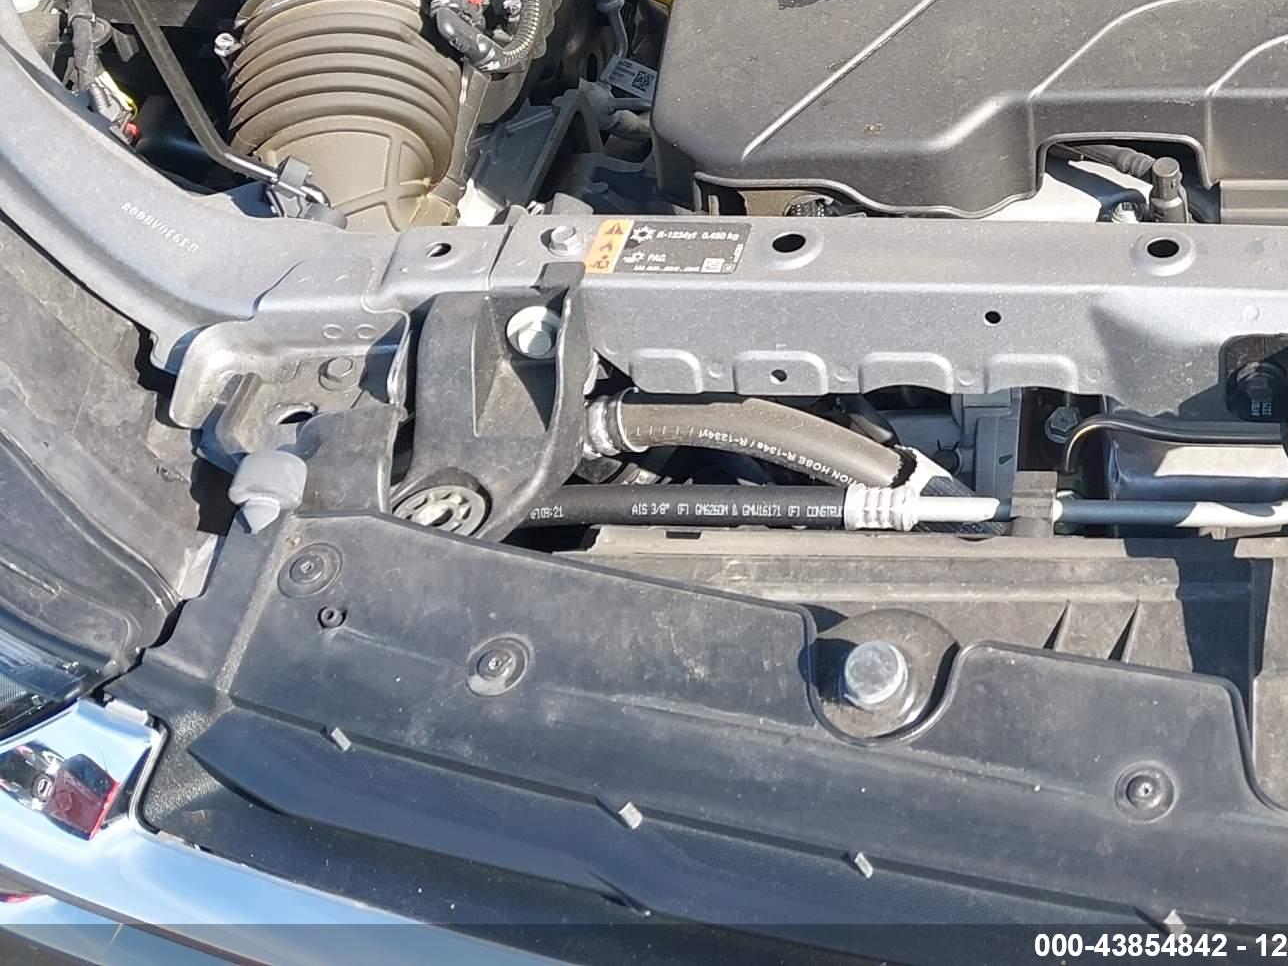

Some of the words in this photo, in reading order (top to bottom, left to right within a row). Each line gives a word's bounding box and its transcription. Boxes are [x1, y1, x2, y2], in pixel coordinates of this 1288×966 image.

[726, 232, 740, 242] kg
[647, 253, 667, 263] PAG
[698, 429, 749, 447] R-1234yf
[757, 441, 797, 462] R-134a
[798, 455, 831, 475] HOSE
